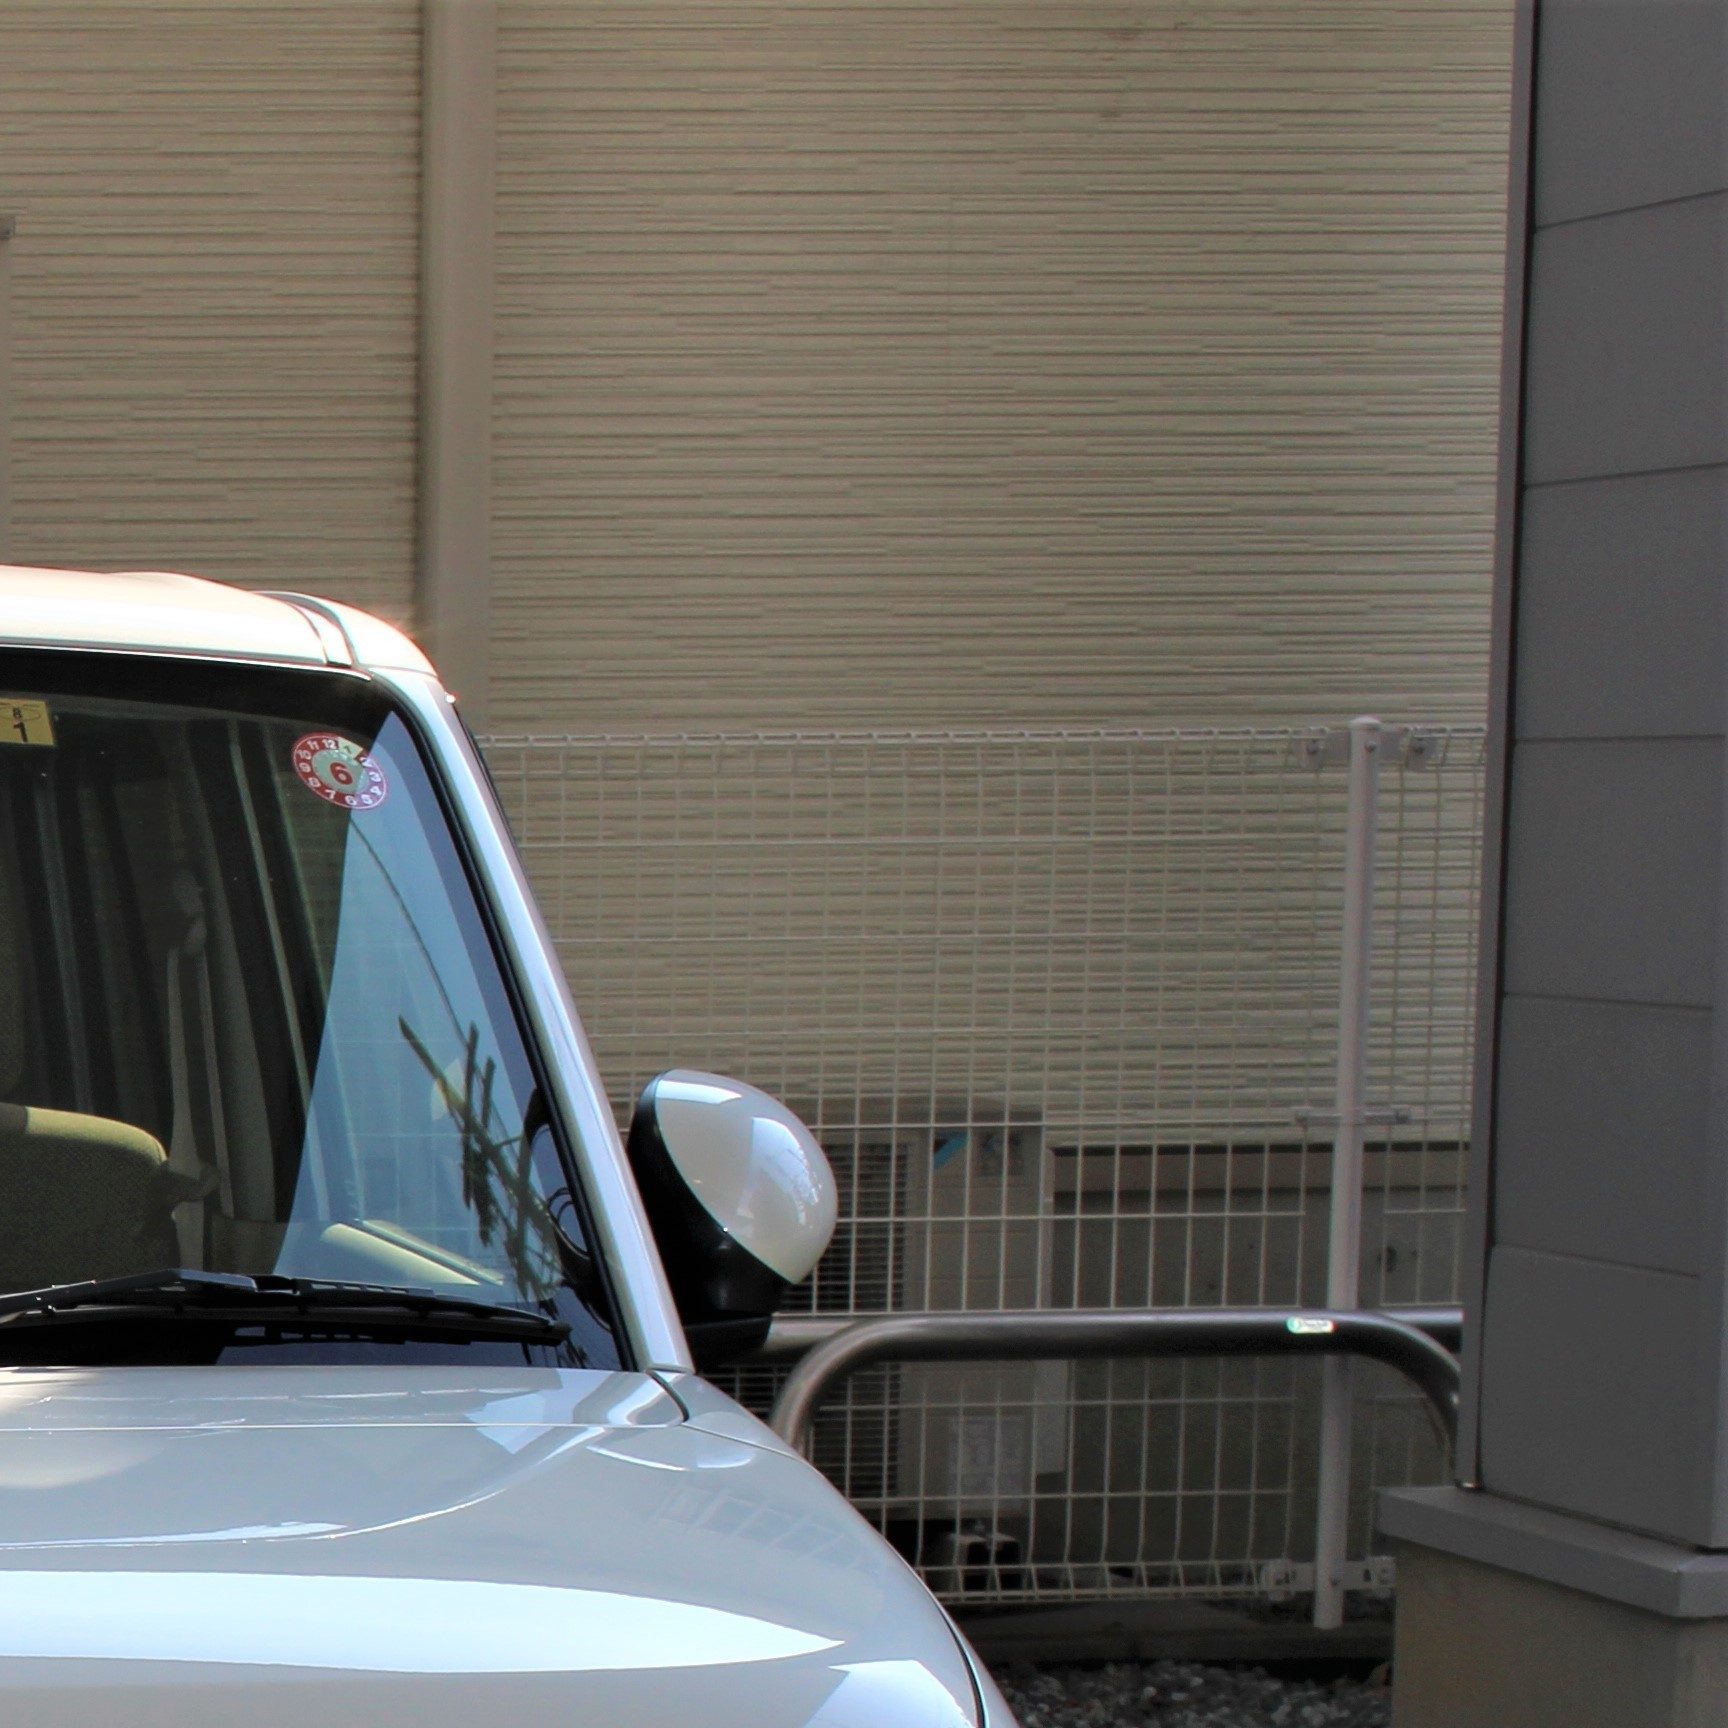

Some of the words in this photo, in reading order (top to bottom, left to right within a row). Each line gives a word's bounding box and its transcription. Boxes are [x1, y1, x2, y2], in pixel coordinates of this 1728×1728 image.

[13, 721, 28, 742] 1
[321, 739, 337, 750] 12
[330, 762, 353, 785] 6
[325, 789, 336, 799] 7
